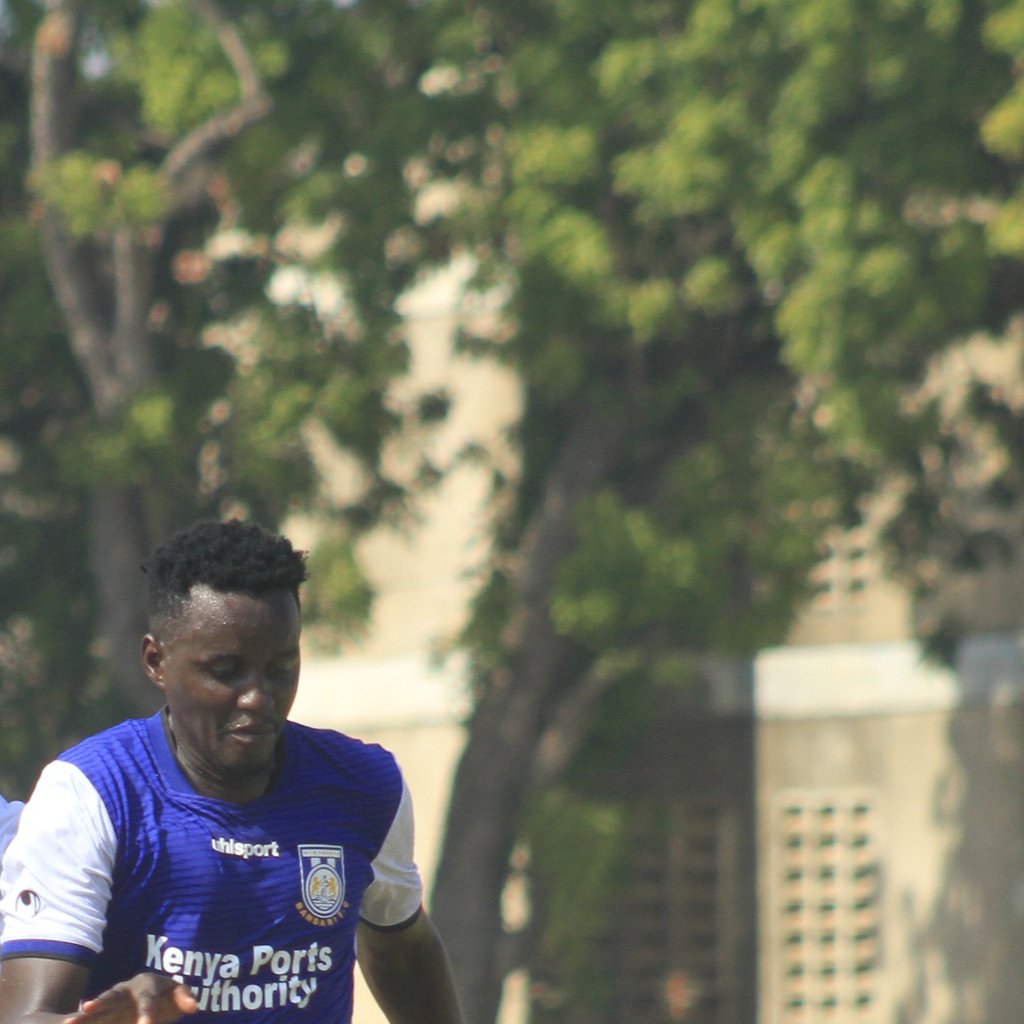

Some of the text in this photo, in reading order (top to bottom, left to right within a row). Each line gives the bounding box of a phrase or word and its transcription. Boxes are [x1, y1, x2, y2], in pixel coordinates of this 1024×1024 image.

[211, 837, 280, 859] uhlsport
[145, 934, 333, 987] Kenya Ports
